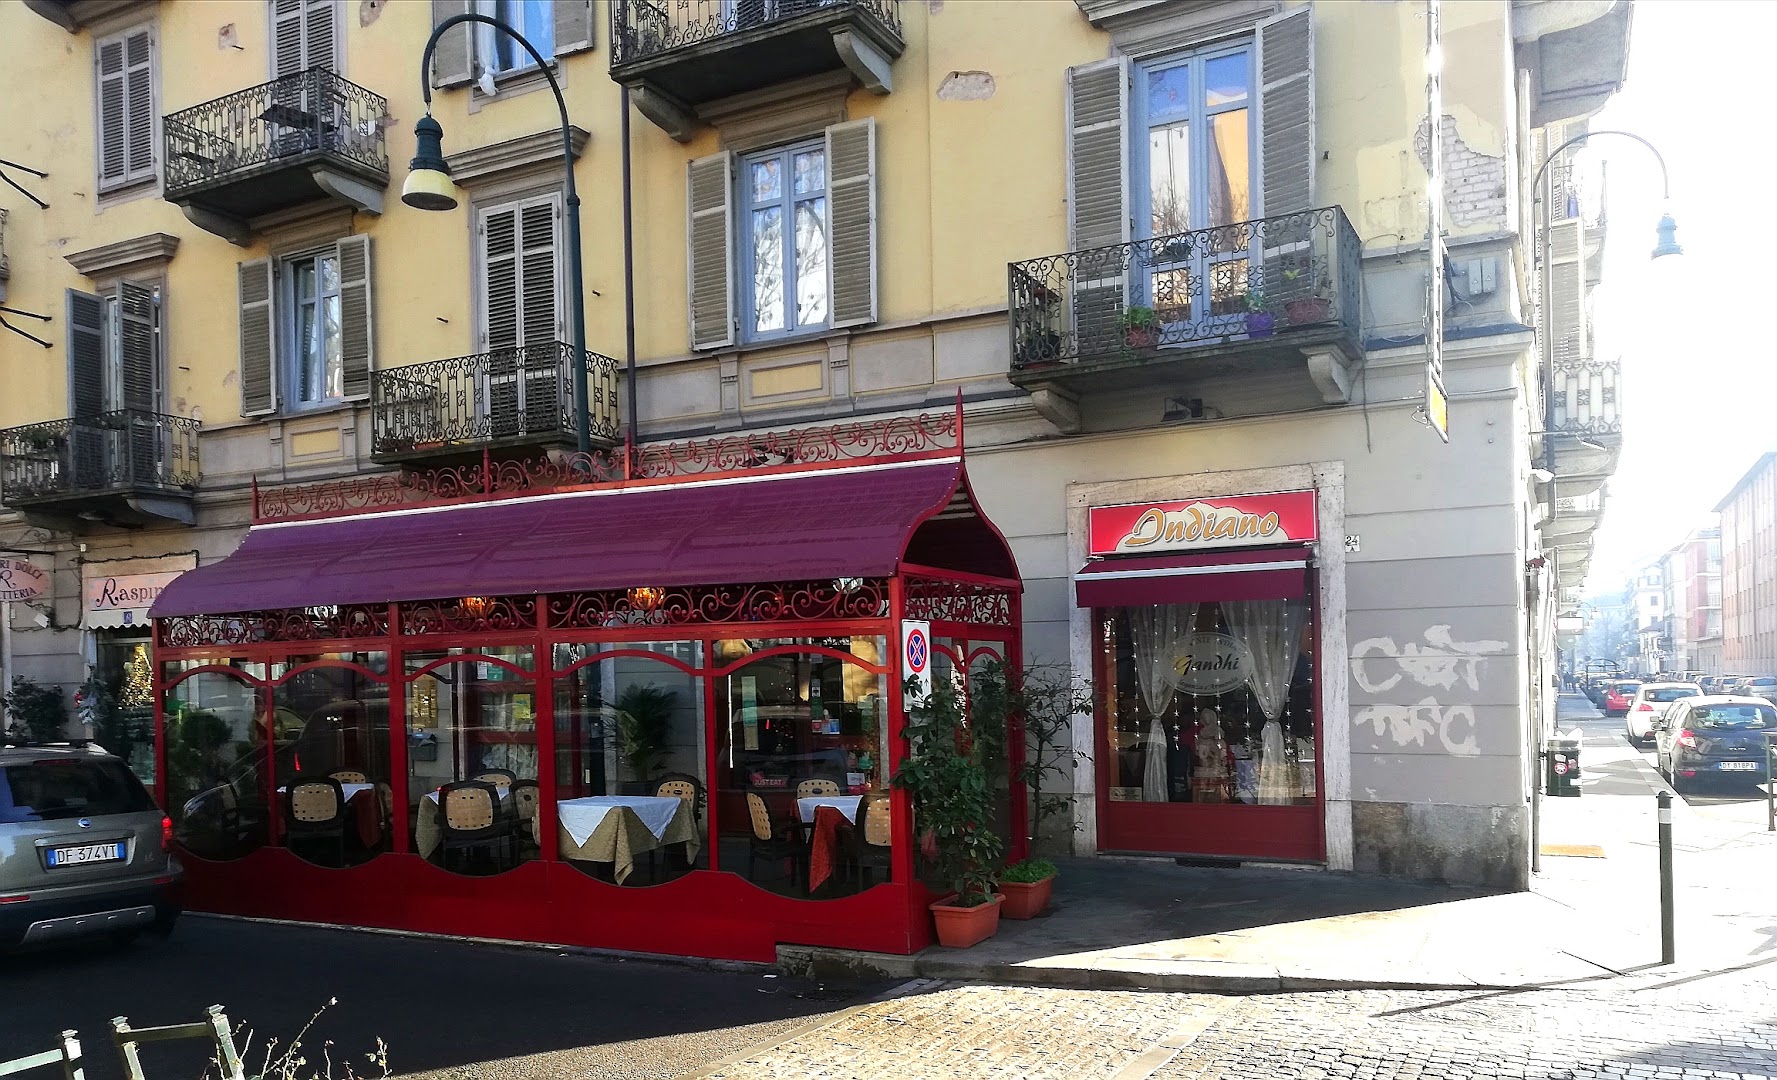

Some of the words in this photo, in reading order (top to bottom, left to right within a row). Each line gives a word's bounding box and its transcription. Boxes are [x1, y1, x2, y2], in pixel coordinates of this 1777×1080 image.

[1124, 508, 1279, 545] Indiano
[1174, 653, 1239, 675] Gandhi
[57, 849, 73, 863] DF
